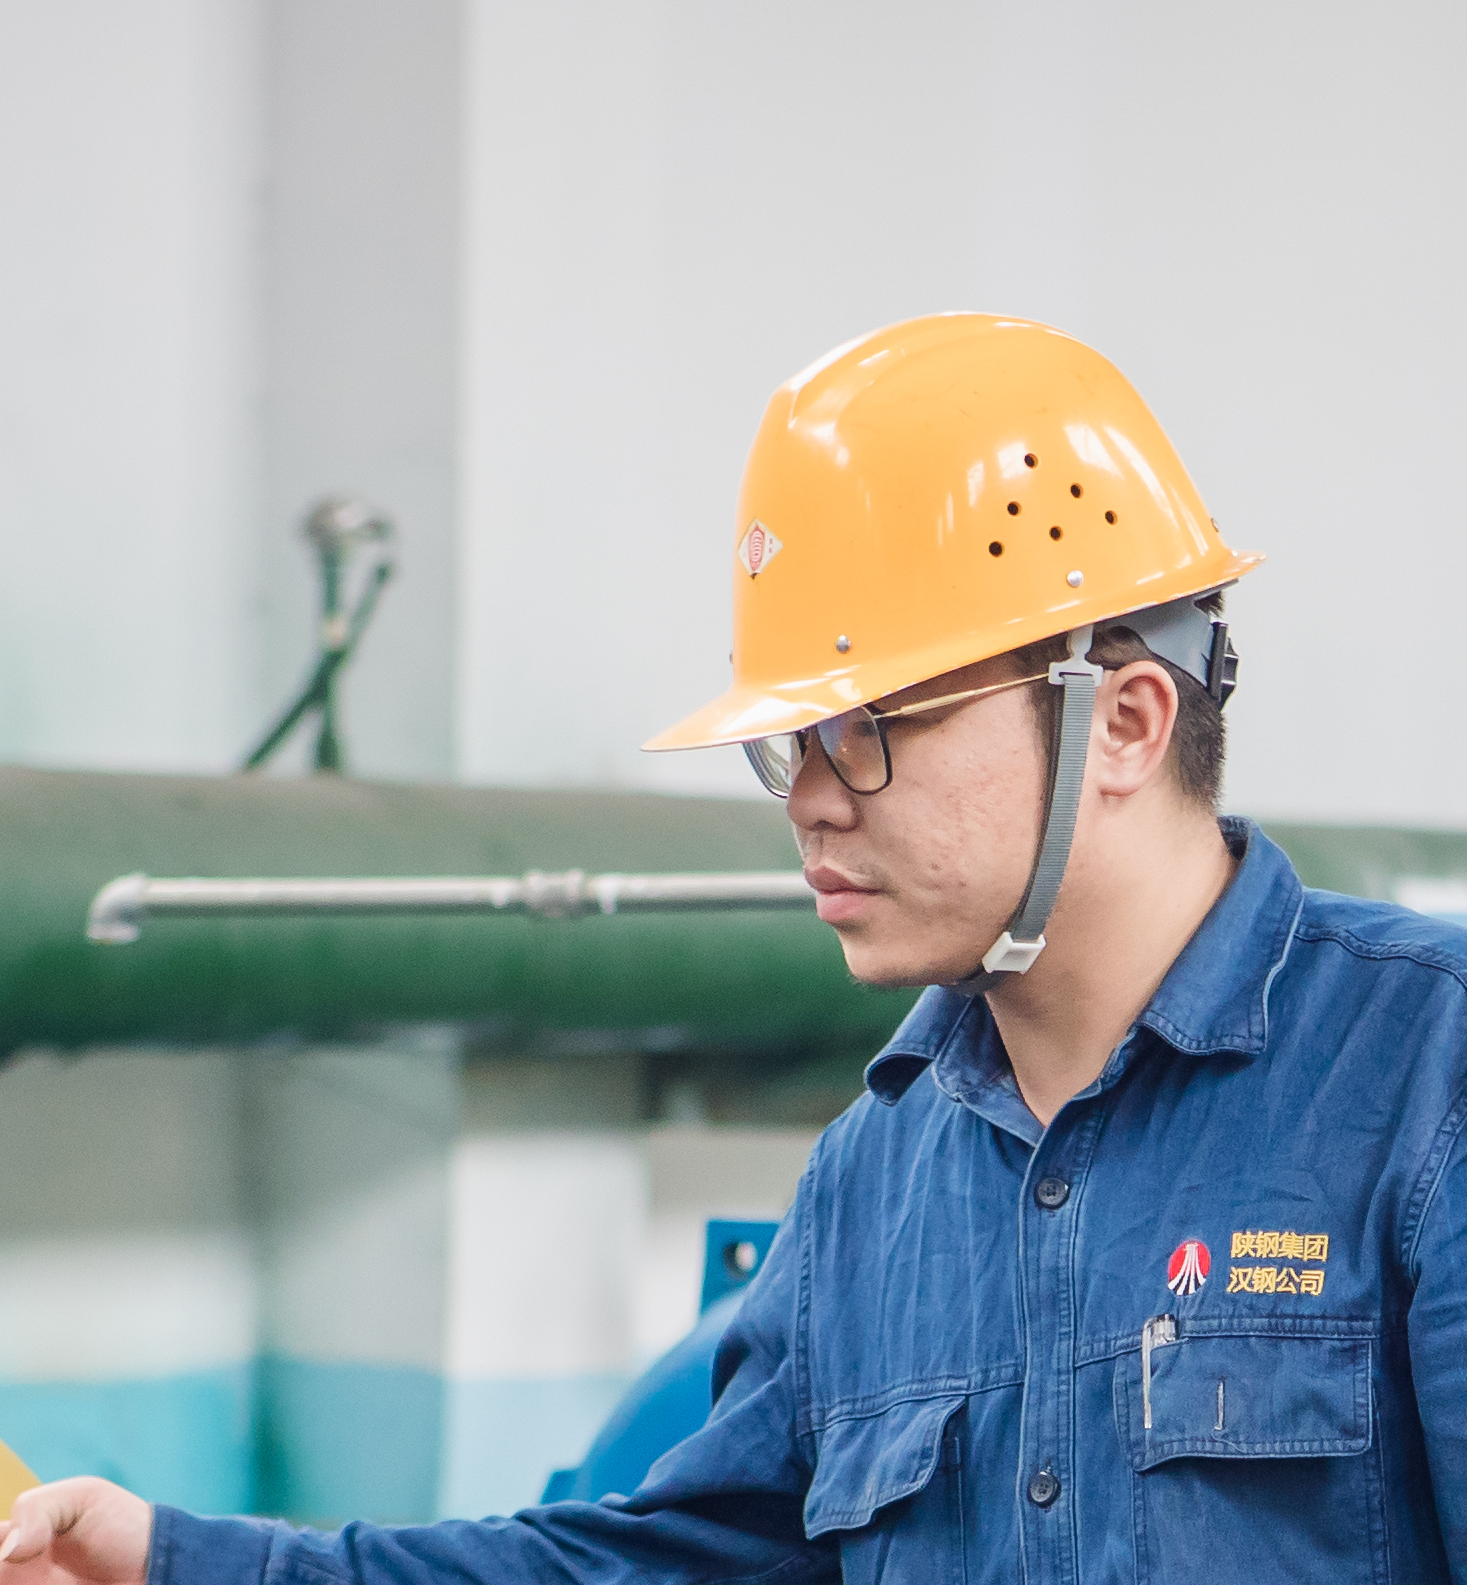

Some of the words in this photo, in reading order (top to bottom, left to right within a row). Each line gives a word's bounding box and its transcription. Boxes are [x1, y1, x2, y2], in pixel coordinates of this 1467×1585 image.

[1231, 1231, 1329, 1262] 陕钢集团
[1226, 1266, 1325, 1295] 汉钢公司
